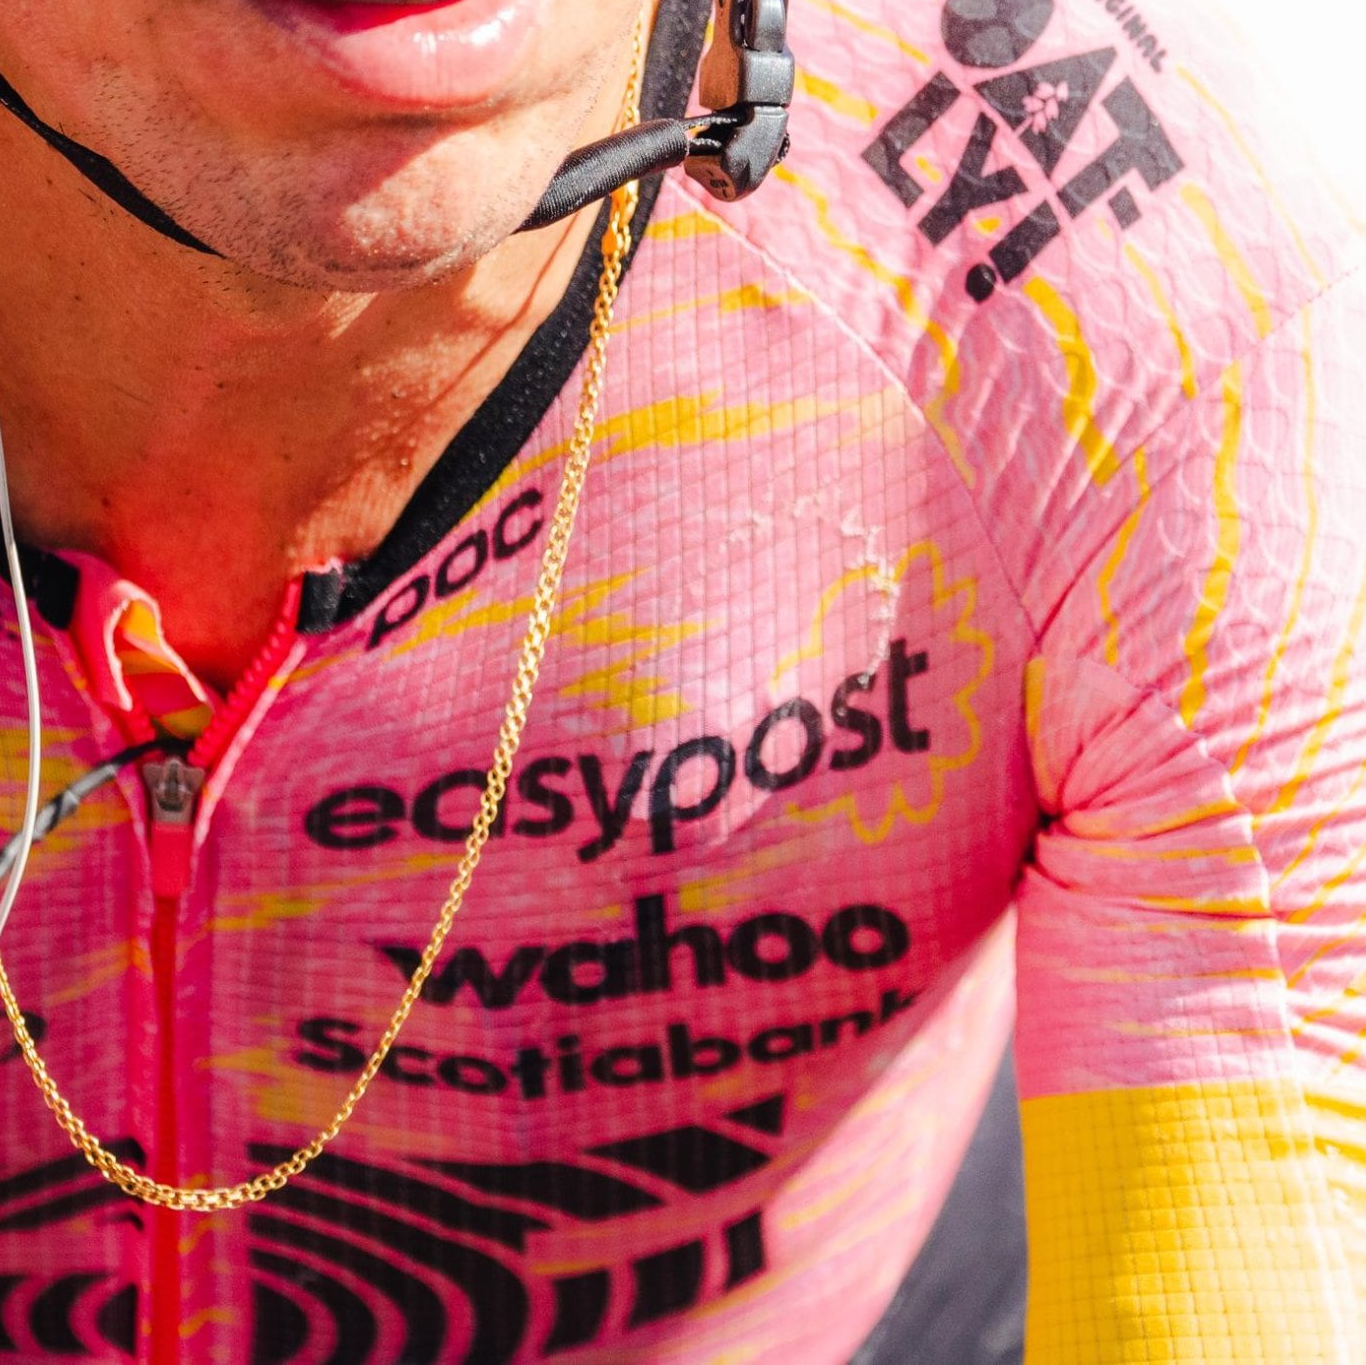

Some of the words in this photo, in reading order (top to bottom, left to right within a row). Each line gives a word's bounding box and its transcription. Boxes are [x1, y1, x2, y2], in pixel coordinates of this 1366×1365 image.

[367, 487, 545, 650] poc
[303, 636, 931, 864] easypost
[373, 895, 911, 1011] wahoo
